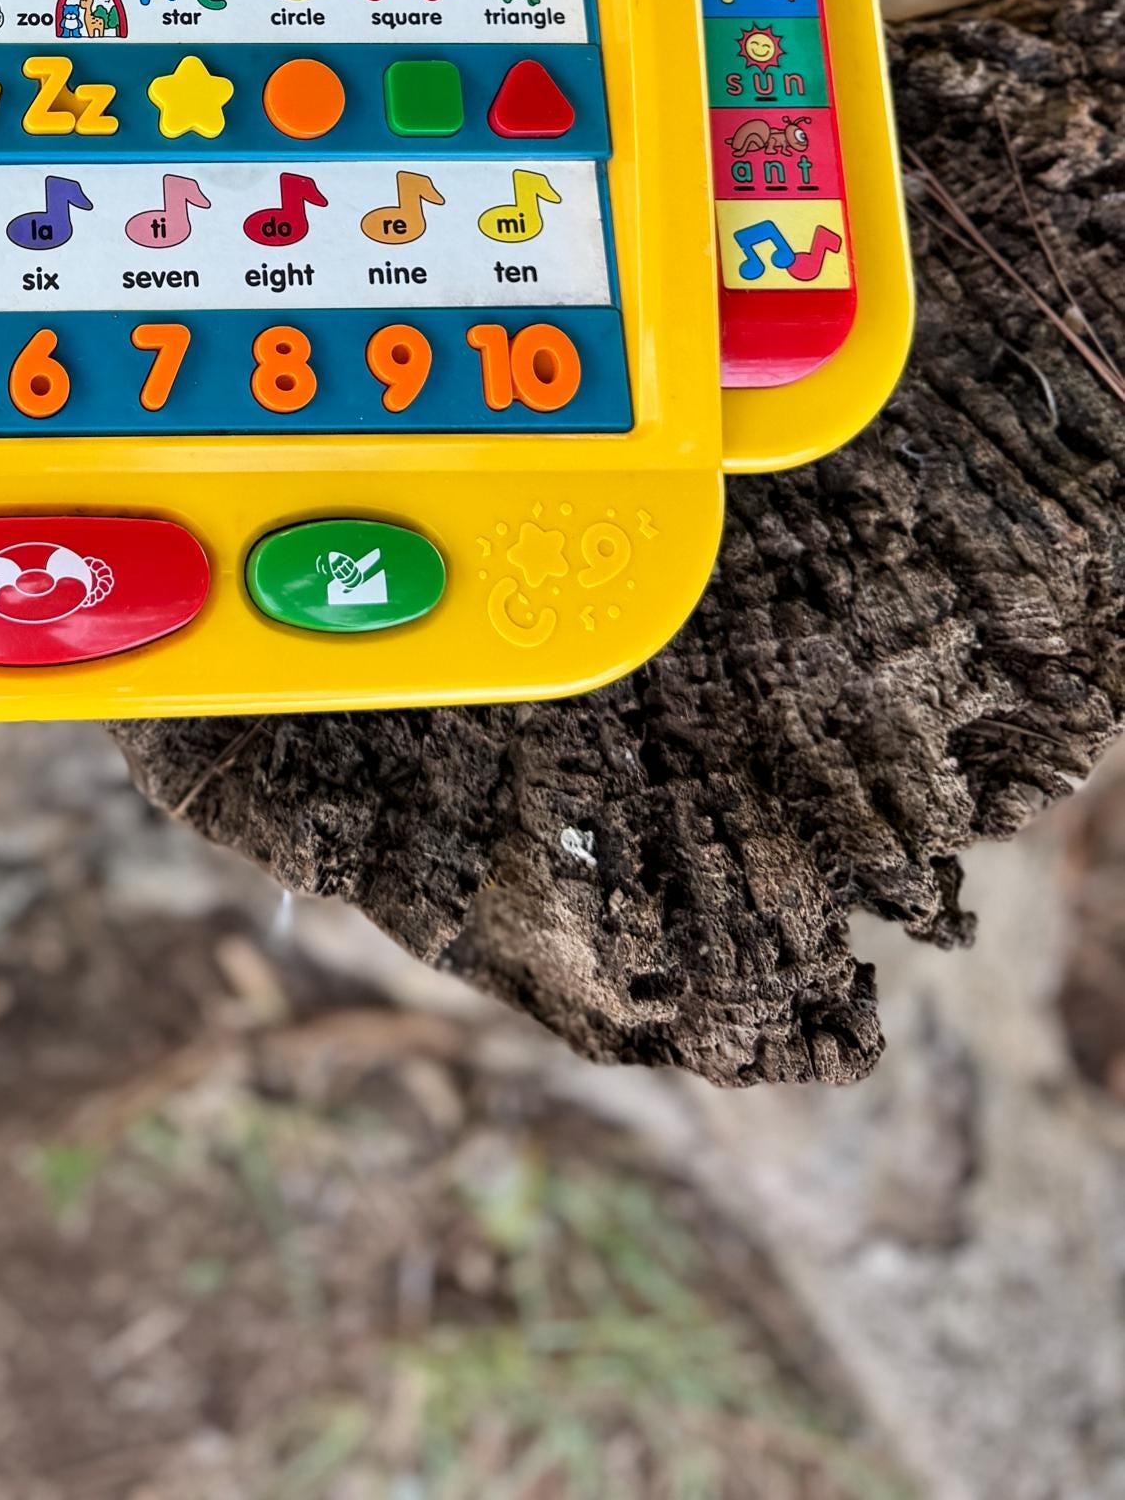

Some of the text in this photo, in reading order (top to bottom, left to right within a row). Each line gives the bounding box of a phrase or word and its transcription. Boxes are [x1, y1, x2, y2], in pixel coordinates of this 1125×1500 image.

[17, 12, 53, 26] zoo
[162, 8, 201, 26] star
[270, 8, 325, 25] circle
[371, 11, 442, 29] square
[485, 7, 565, 28] triangle
[22, 56, 119, 136] Zz
[31, 219, 53, 240] la
[151, 218, 166, 239] ti
[261, 217, 292, 238] do
[383, 217, 407, 235] re
[497, 214, 525, 233] mi
[22, 267, 60, 290] six
[123, 267, 199, 289] seven
[245, 263, 315, 293] eight
[368, 262, 427, 285] nine
[494, 261, 537, 283] ten
[8, 328, 70, 419] 6
[131, 324, 191, 412] 7
[251, 326, 317, 413] 8
[366, 324, 432, 413] 9
[466, 323, 581, 412] 10
